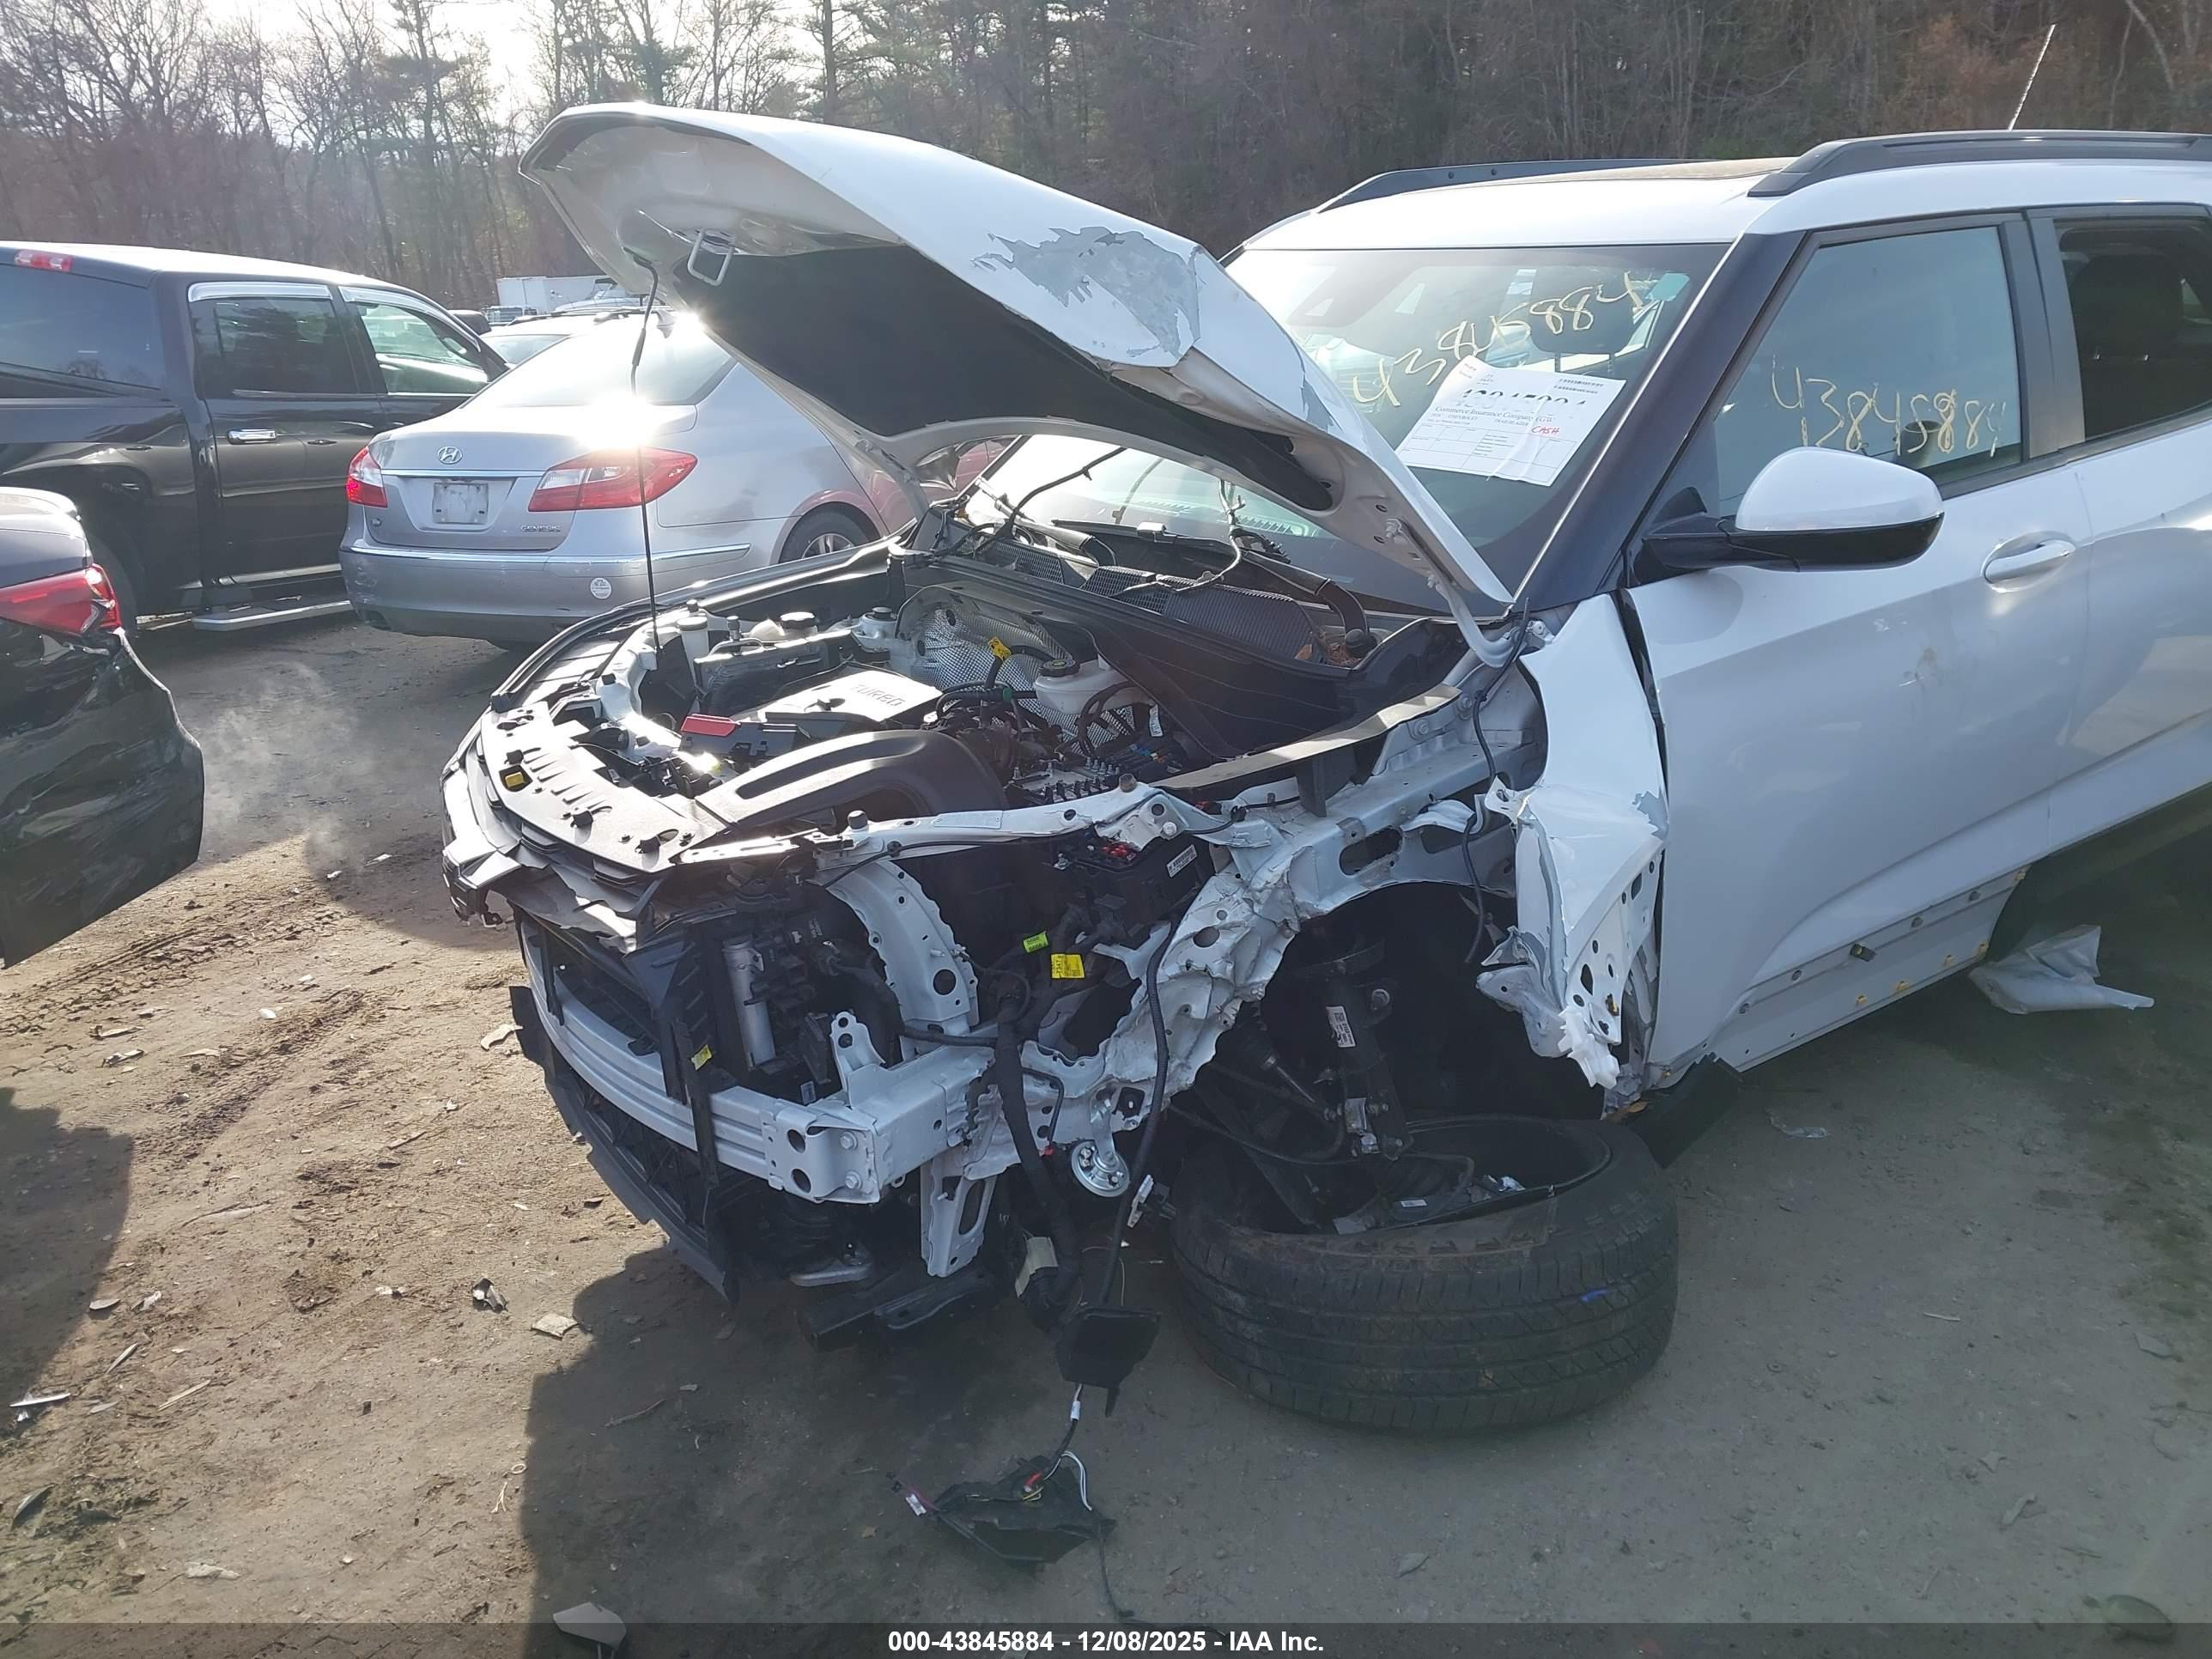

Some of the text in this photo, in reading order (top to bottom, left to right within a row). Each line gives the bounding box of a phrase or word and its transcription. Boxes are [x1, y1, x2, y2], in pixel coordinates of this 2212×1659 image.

[1435, 405, 1470, 415] Commerce
[1470, 408, 1503, 418] Insurance
[1531, 425, 1560, 435] CASH
